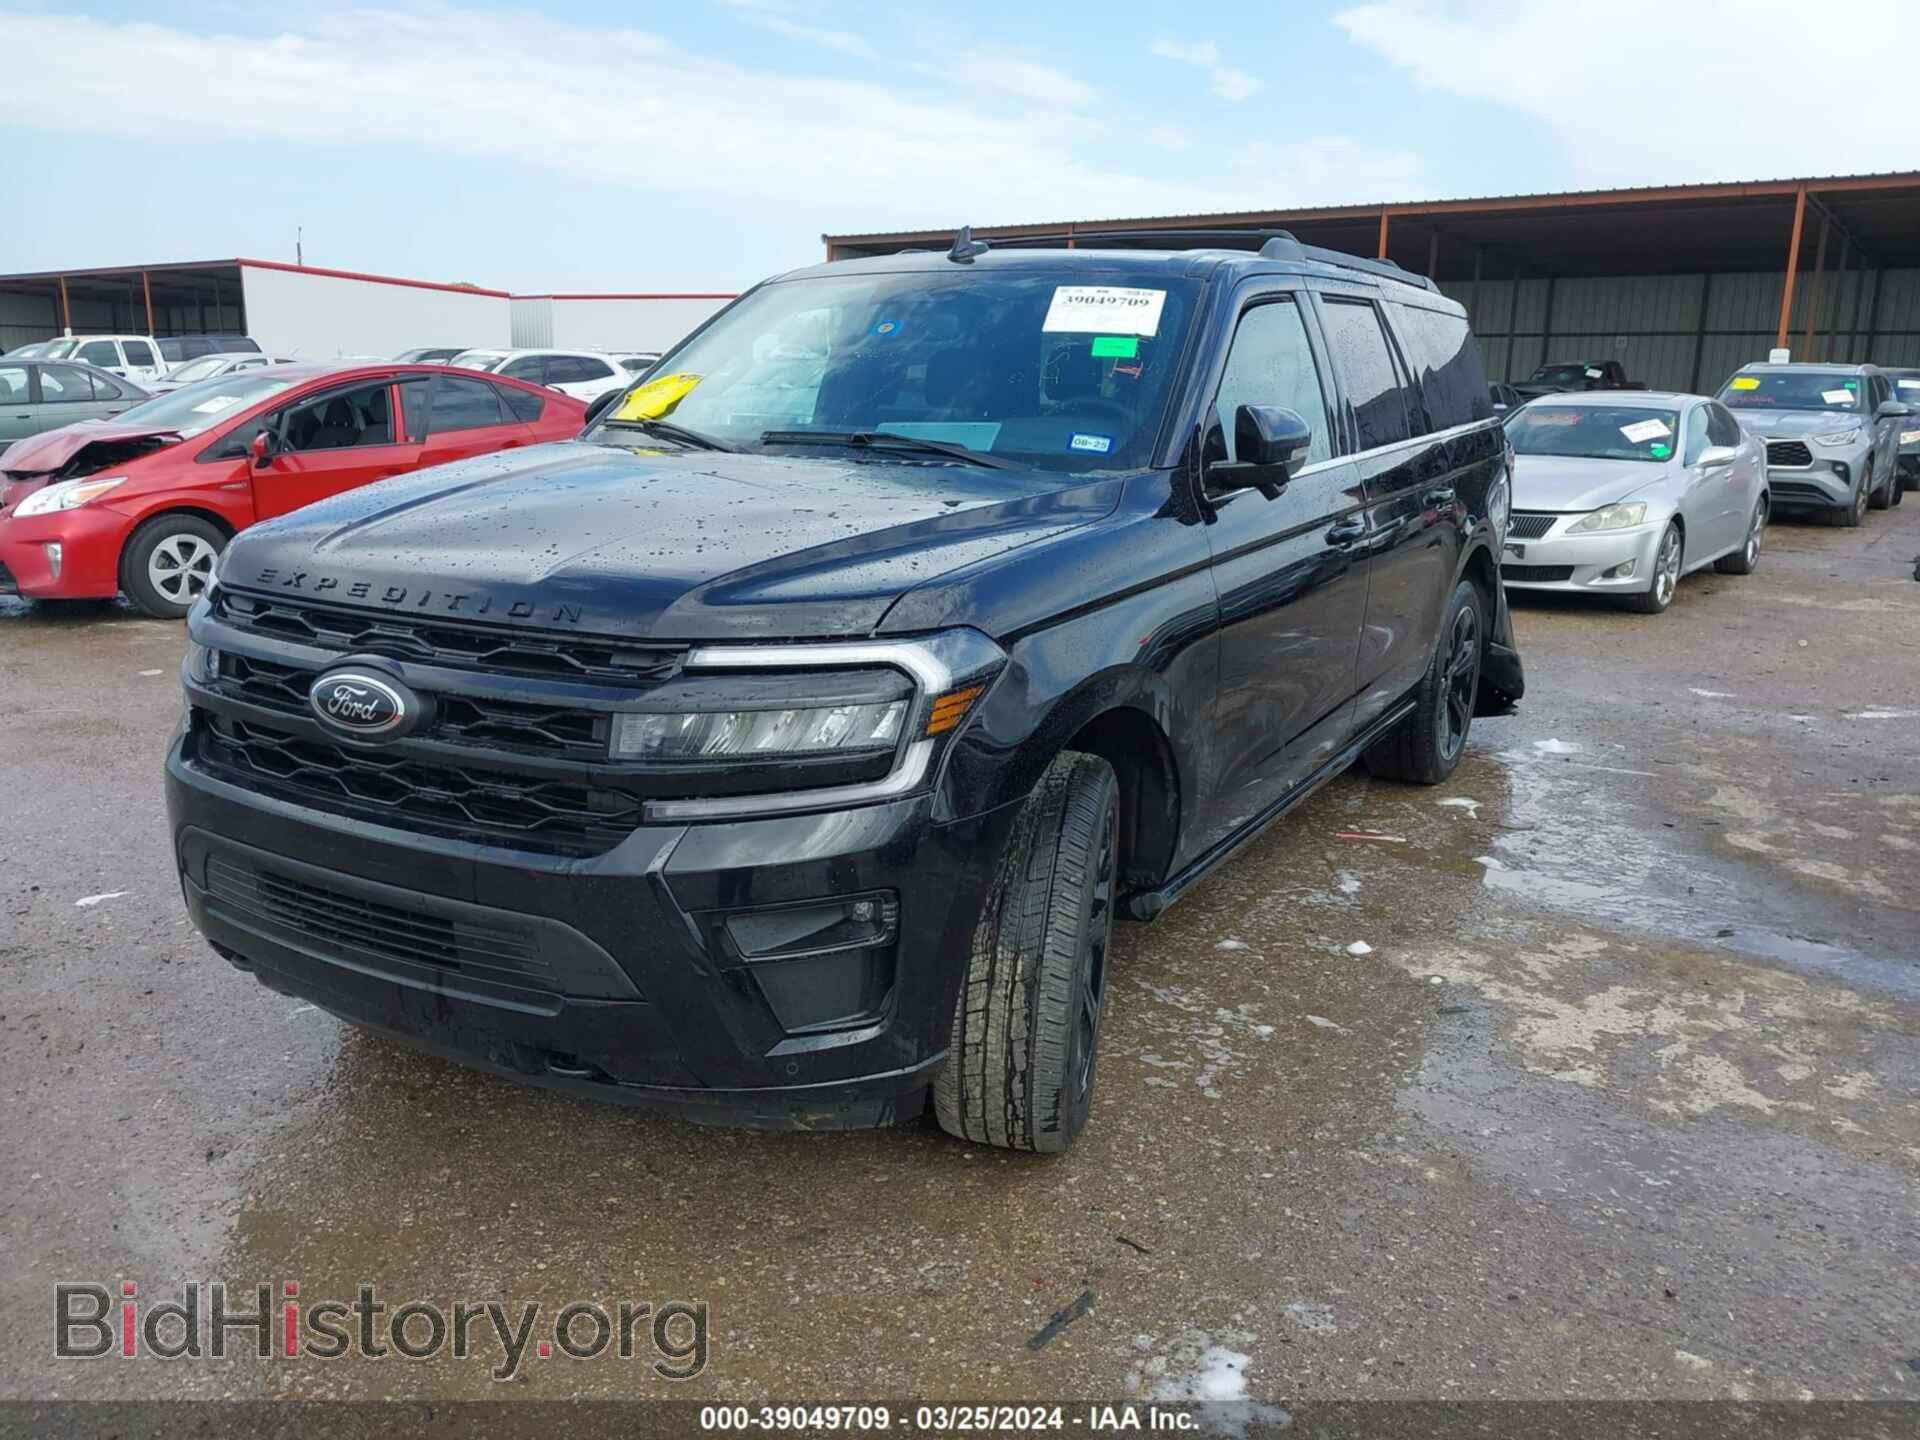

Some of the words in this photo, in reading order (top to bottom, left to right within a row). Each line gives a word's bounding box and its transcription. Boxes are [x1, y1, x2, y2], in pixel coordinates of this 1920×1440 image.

[1063, 295, 1150, 306] 39049709
[257, 568, 583, 623] EXPEDITION
[327, 684, 378, 721] Ford
